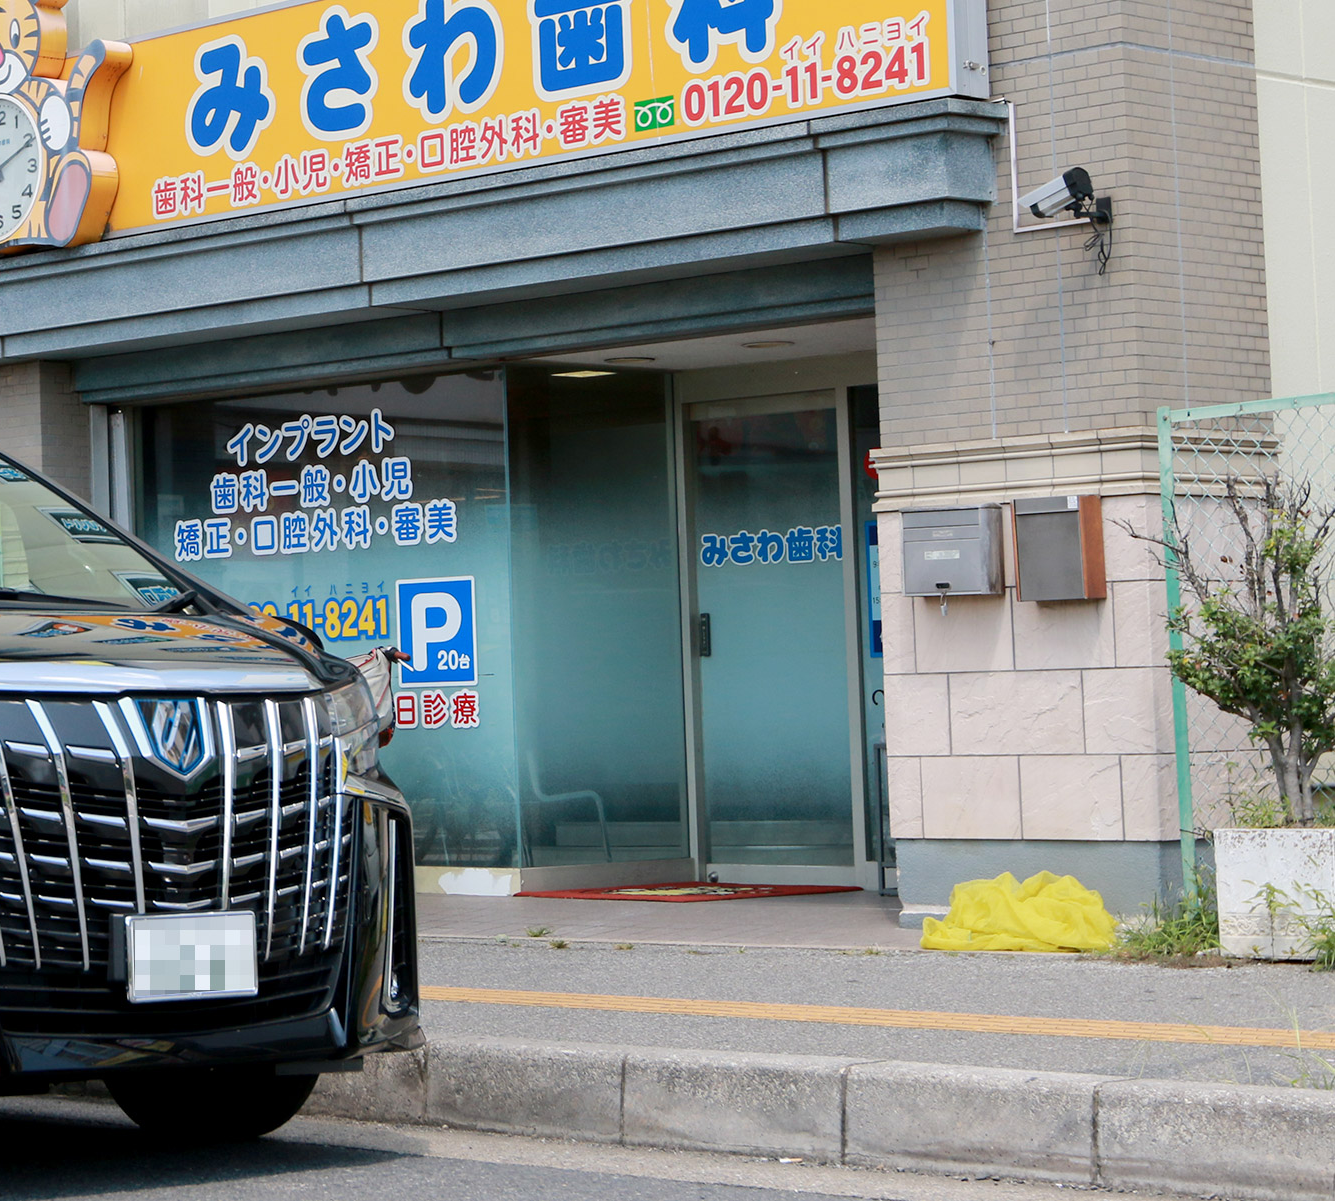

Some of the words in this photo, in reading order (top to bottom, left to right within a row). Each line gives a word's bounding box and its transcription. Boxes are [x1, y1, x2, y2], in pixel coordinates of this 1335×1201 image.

[782, 38, 821, 61] イイ
[837, 16, 929, 53] ハニヨイ
[684, 41, 928, 122] 0120-11-8241
[15, 115, 19, 128] 1
[27, 158, 38, 173] 3
[12, 205, 22, 219] 5
[21, 184, 33, 198] 4
[229, 409, 393, 465] インプラント
[212, 460, 411, 511] 歯科一般・小児
[176, 502, 457, 559] 矯正・口腔外科・審美
[701, 525, 842, 566] みさわ歯科
[410, 592, 463, 672] P
[436, 650, 471, 671] 20台
